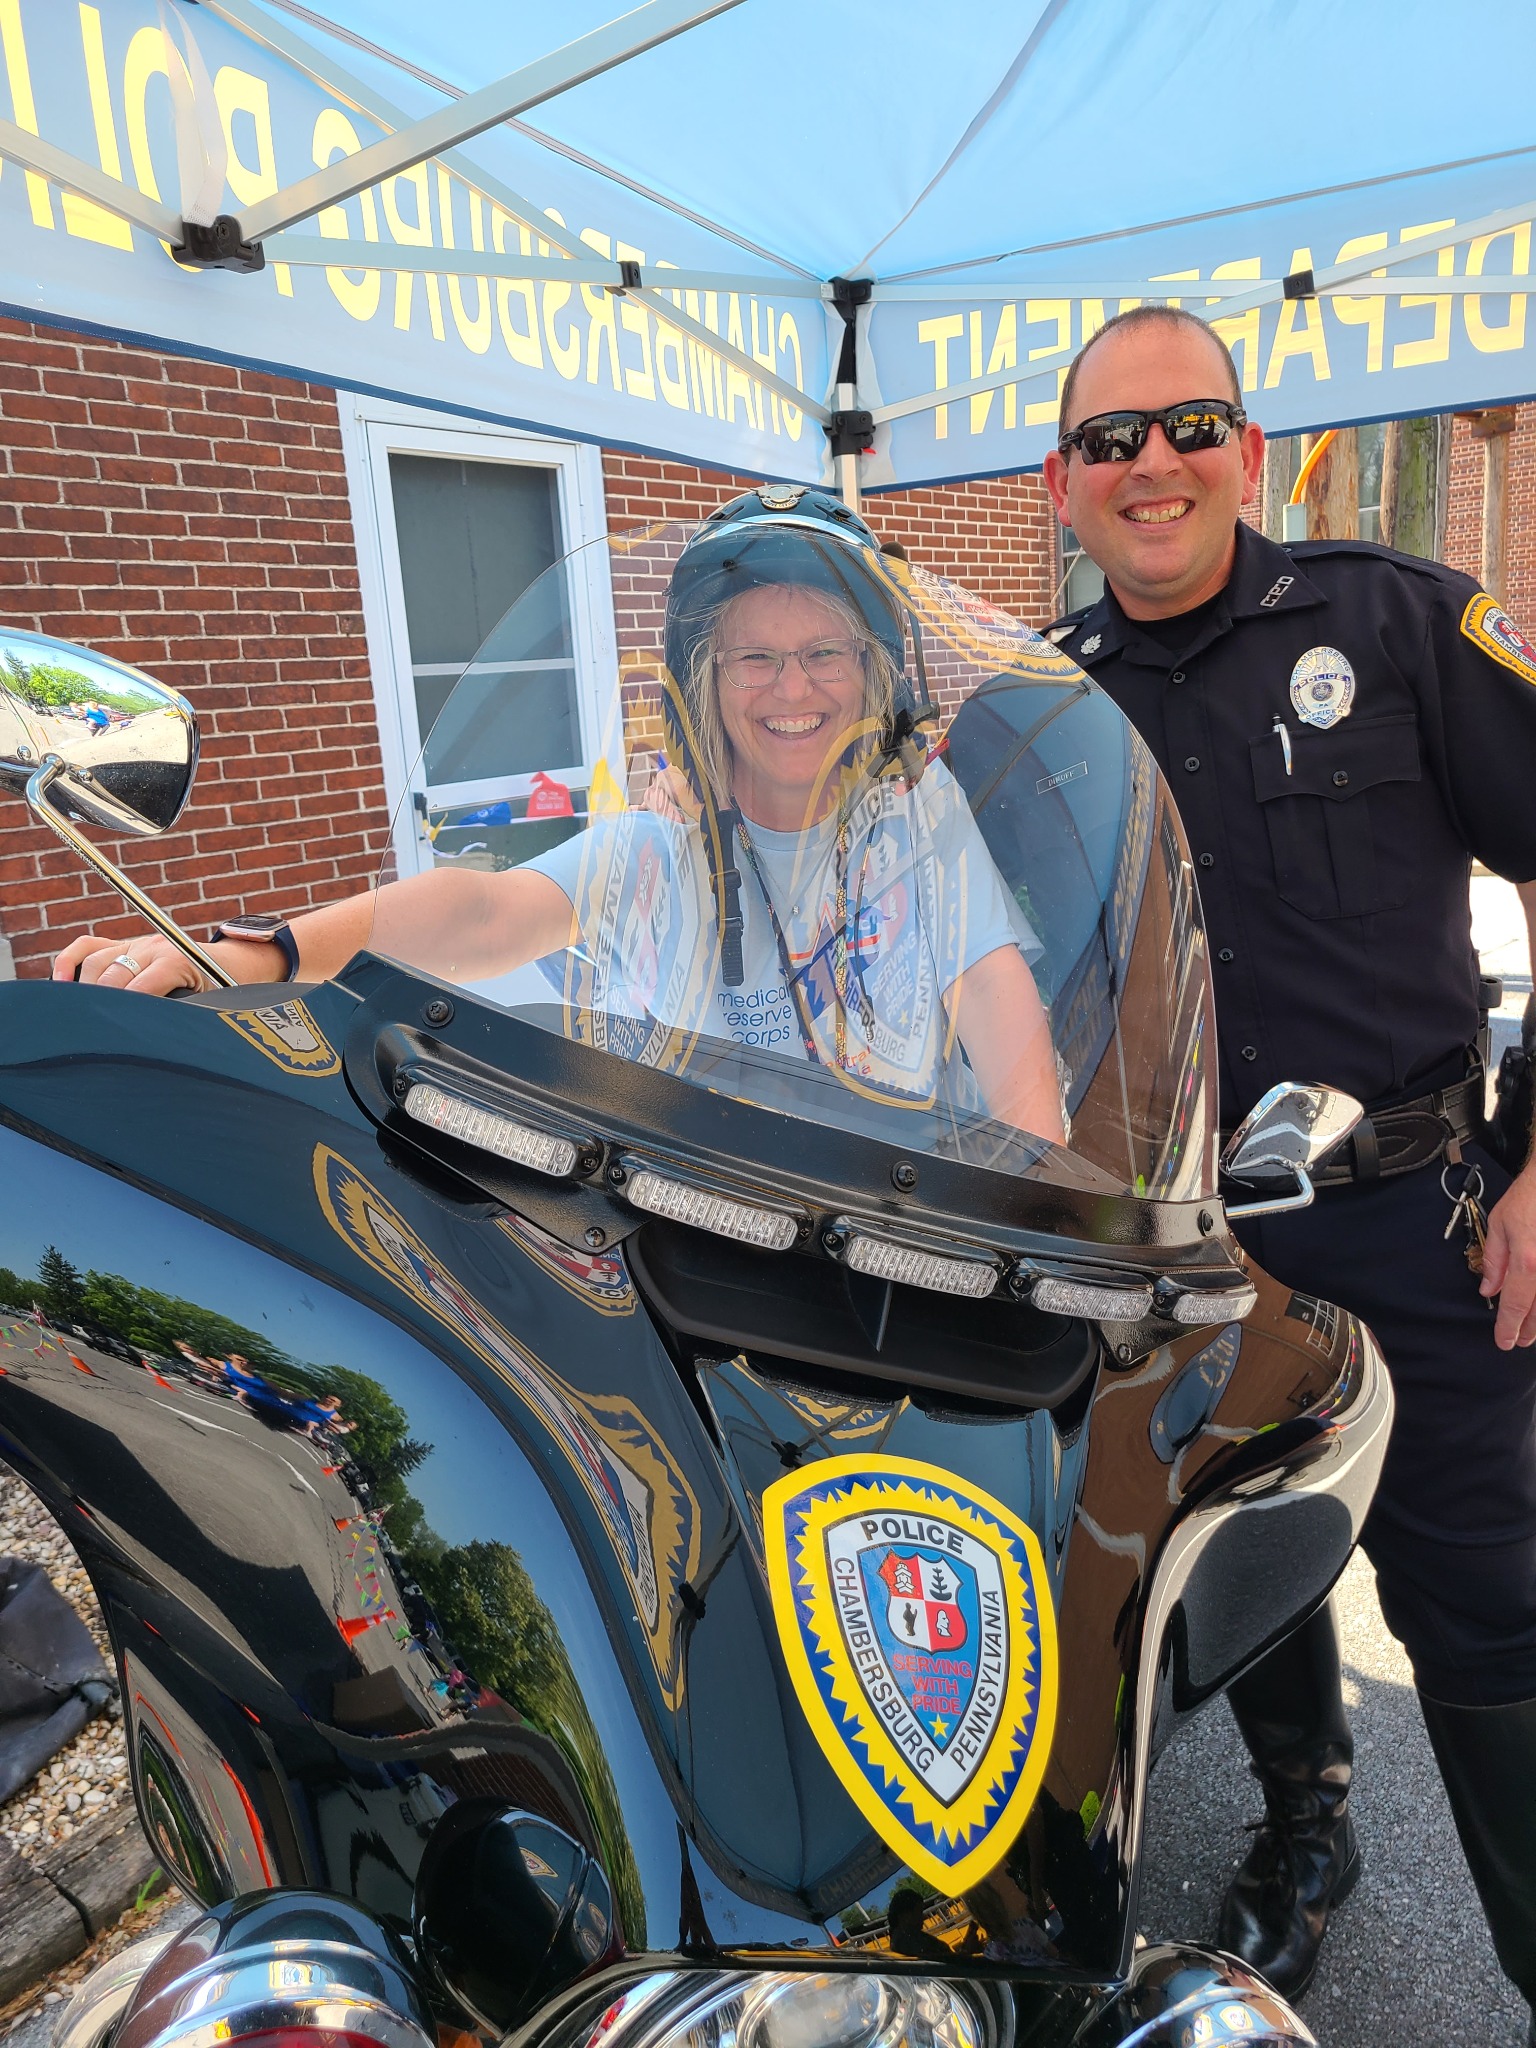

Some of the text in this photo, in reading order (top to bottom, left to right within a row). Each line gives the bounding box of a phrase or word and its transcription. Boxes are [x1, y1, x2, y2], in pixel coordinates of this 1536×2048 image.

[1260, 575, 1295, 607] CPD
[1300, 673, 1345, 689] POLICE
[1306, 709, 1344, 720] OFFICER
[718, 984, 790, 1010] medical
[723, 1005, 792, 1027] reserve
[731, 1025, 790, 1047] corps
[860, 1516, 965, 1554] POLICE
[832, 1556, 936, 1773] CHAMBERSBURG
[892, 1652, 973, 1678] SERVING
[912, 1675, 959, 1696] WITH
[951, 1589, 999, 1772] PENNSYLVANIA
[912, 1694, 962, 1715] PRIDE
